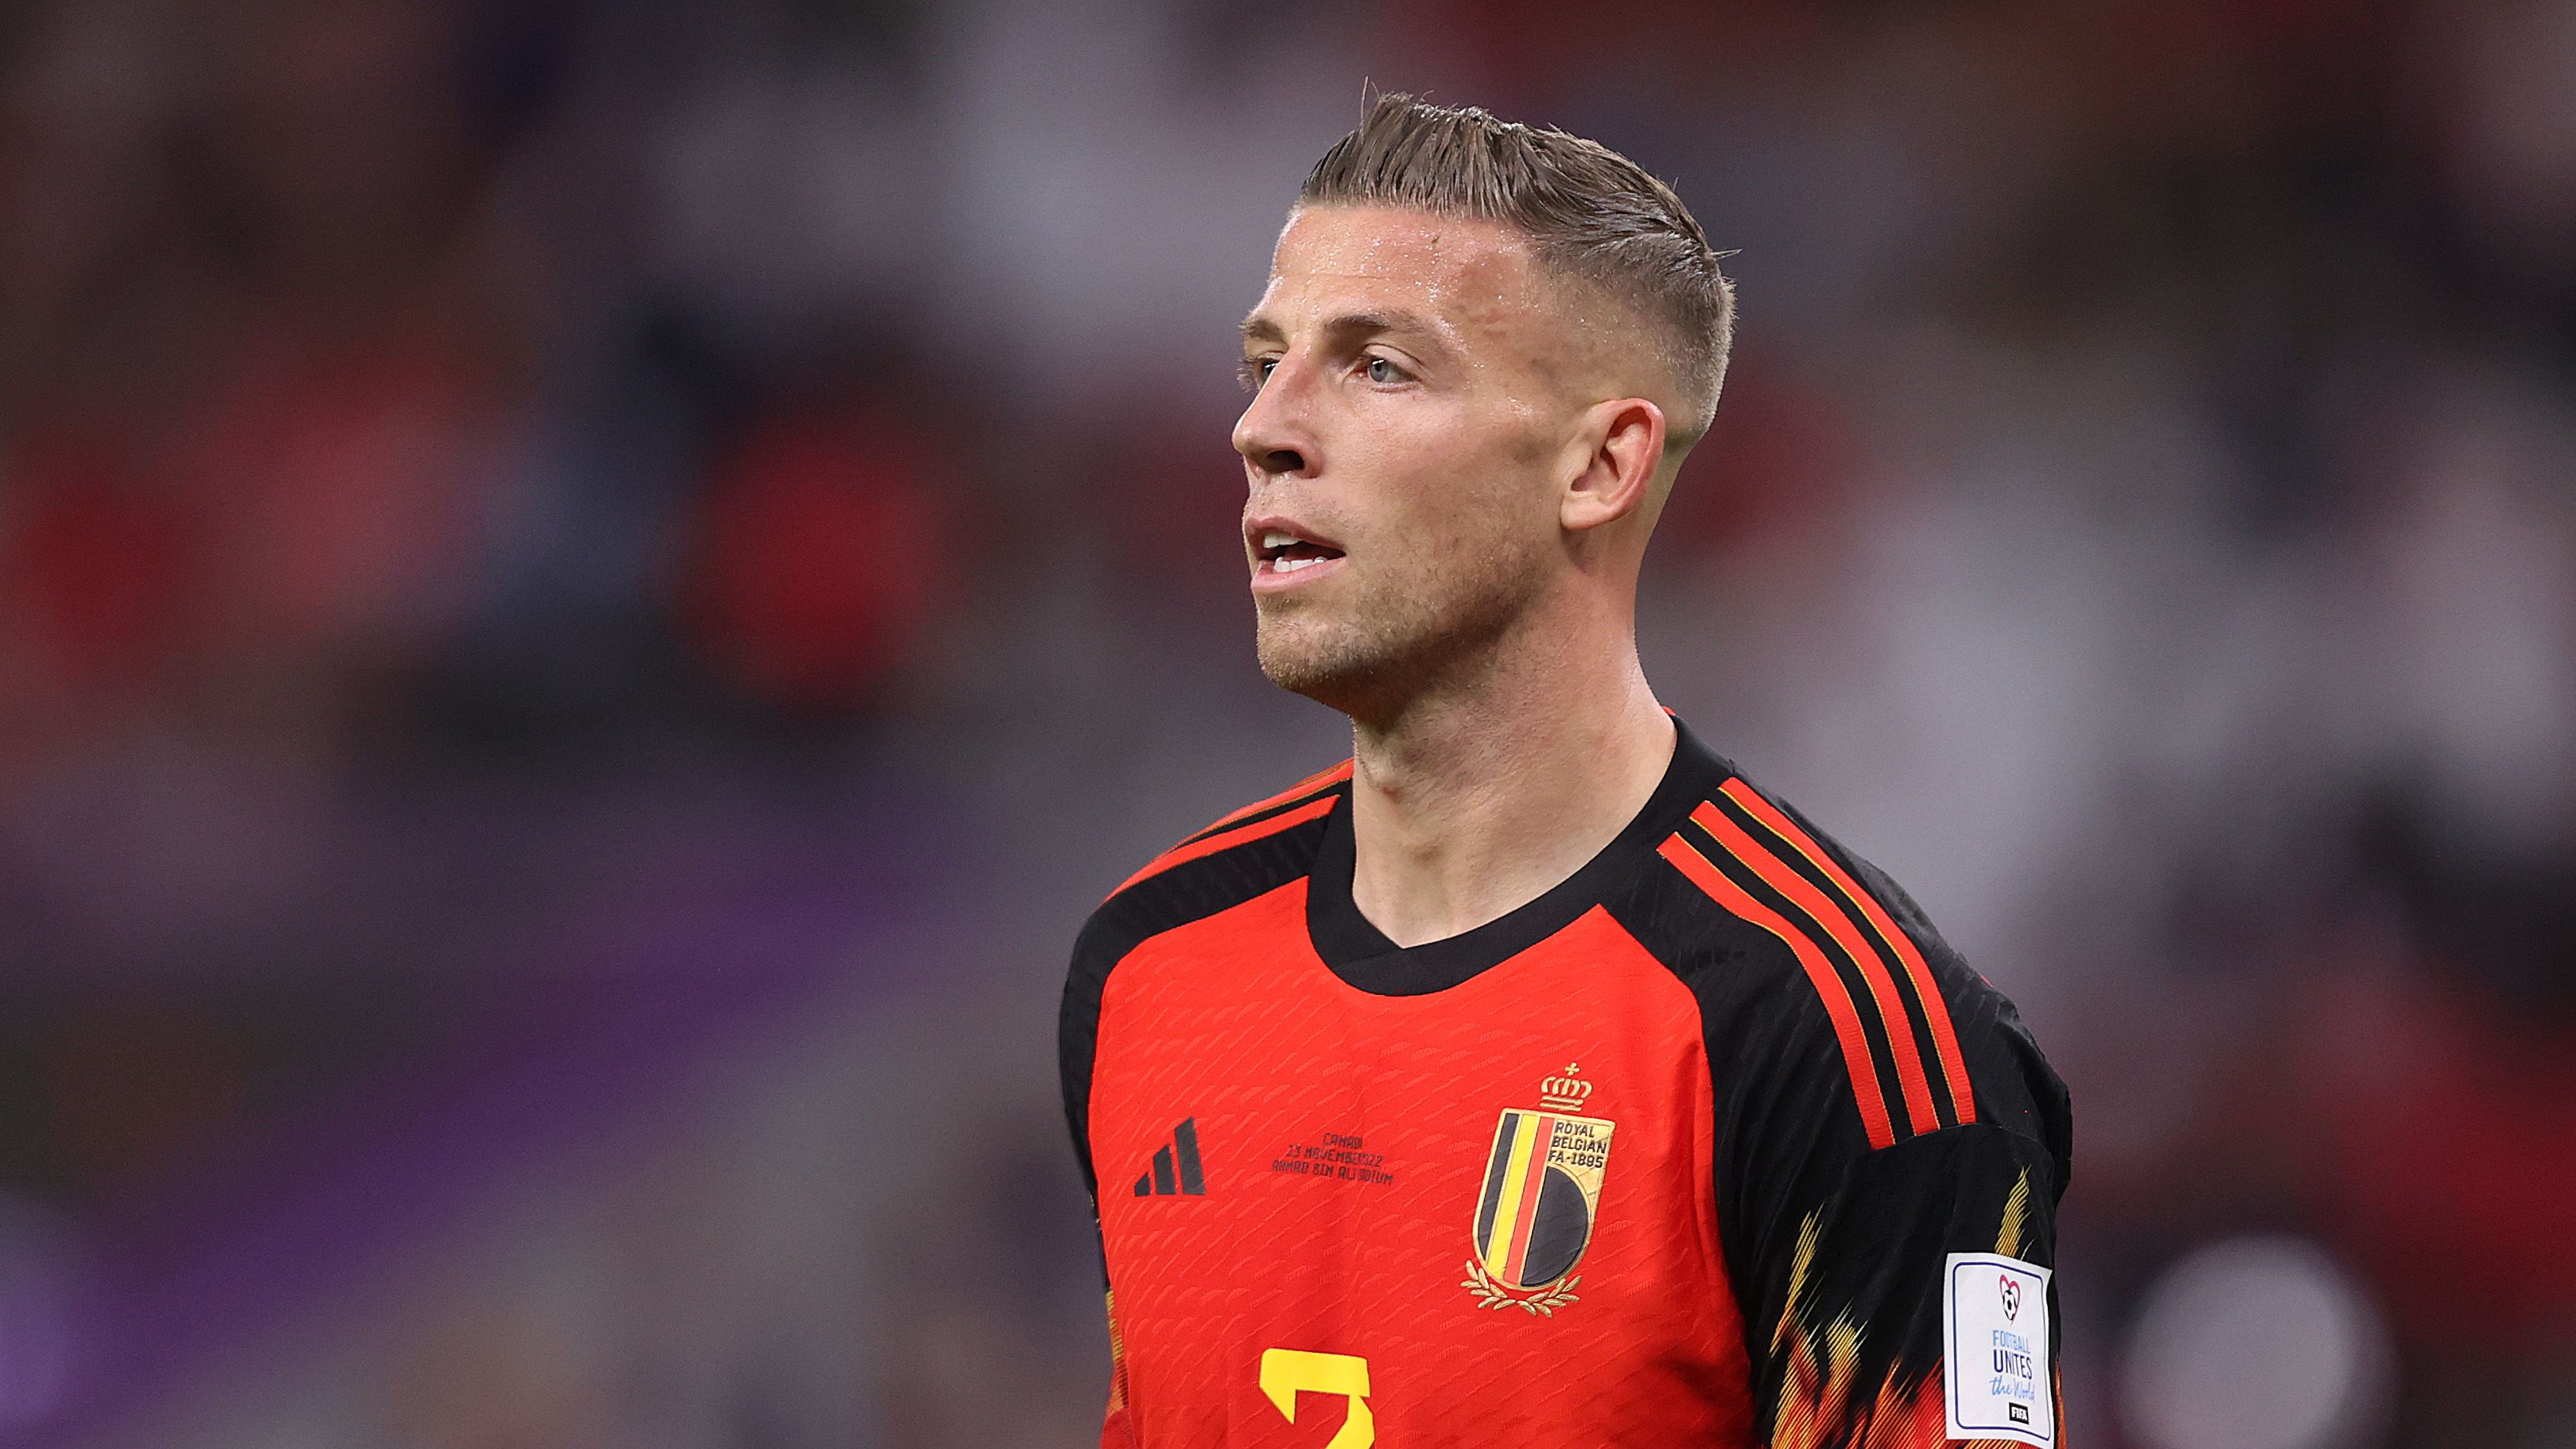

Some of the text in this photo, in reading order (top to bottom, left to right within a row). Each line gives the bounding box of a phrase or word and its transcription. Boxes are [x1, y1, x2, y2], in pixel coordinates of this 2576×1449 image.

[1555, 1122, 1595, 1138] ROYAL
[1552, 1136, 1607, 1154] BELGIAN
[1548, 1150, 1603, 1168] FA-1895
[1313, 1163, 1334, 1178] BIN
[1993, 1330, 2030, 1354] FOOTBALL
[1994, 1350, 2032, 1380] UNITES
[1989, 1376, 2035, 1404] the World
[2011, 1407, 2028, 1421] FIFA
